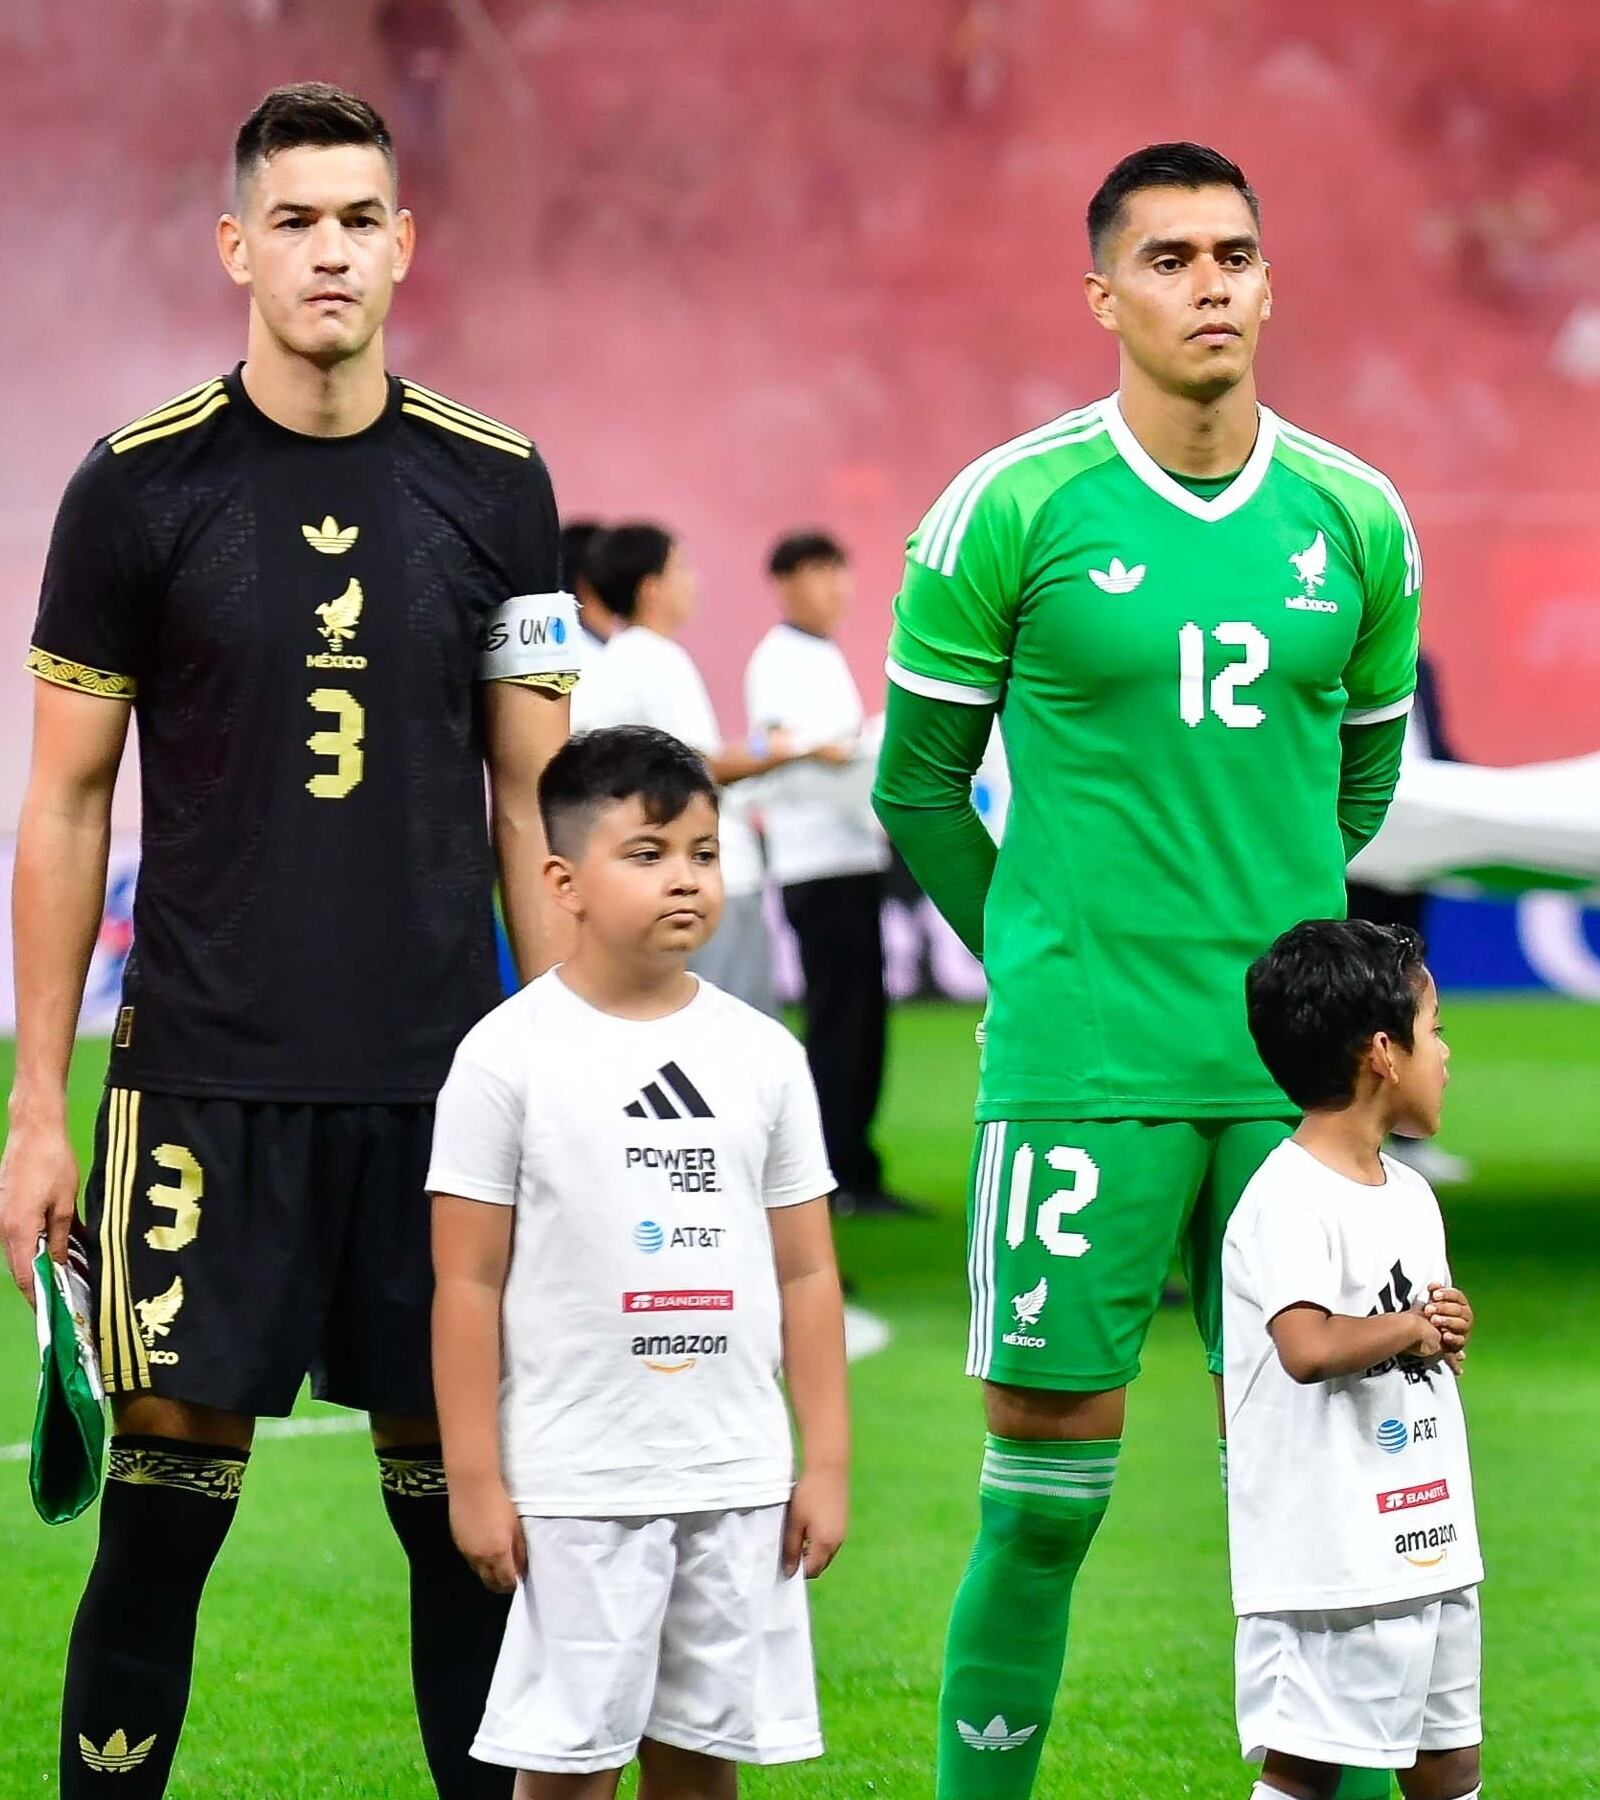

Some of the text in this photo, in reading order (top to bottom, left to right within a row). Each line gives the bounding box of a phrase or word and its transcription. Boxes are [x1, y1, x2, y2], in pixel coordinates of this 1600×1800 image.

[305, 652, 368, 669] MÉXICO
[1178, 620, 1270, 728] 12
[305, 687, 366, 799] 3
[625, 1147, 717, 1170] POWER
[143, 1143, 204, 1252] 3
[1005, 1142, 1101, 1258] 12
[670, 1227, 720, 1248] AT&T
[653, 1295, 732, 1308] BANORTE
[631, 1335, 728, 1355] amazon
[1002, 1330, 1047, 1348] MÉXICO
[1394, 1523, 1458, 1555] amazon
